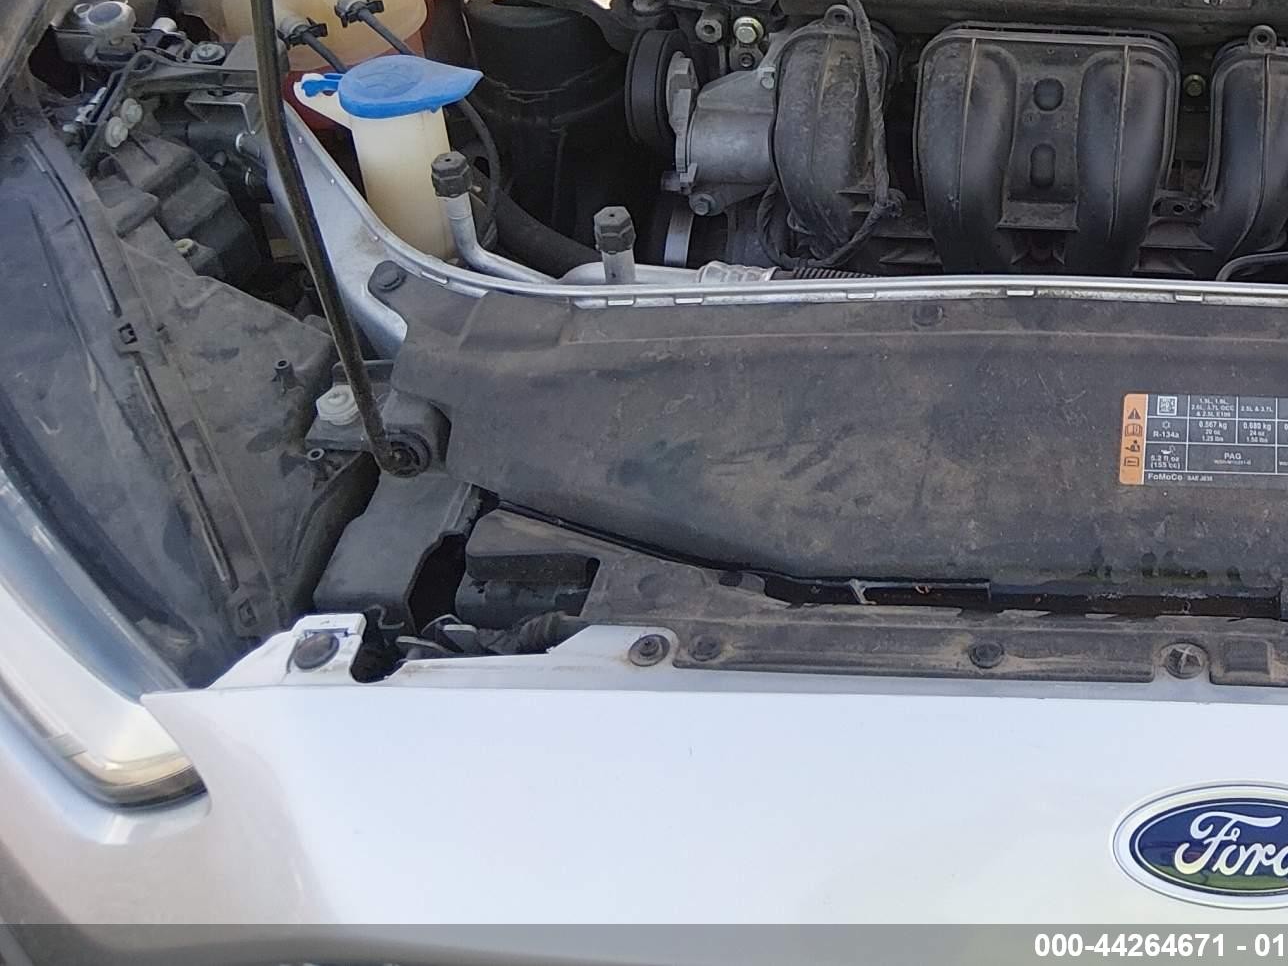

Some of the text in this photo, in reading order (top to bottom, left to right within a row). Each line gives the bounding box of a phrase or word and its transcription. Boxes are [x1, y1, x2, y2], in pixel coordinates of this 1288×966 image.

[1218, 421, 1228, 431] kg
[1262, 422, 1272, 432] kg
[1153, 430, 1180, 439] R-134a
[1224, 452, 1242, 460] PAG
[1147, 472, 1183, 481] FoMoCo
